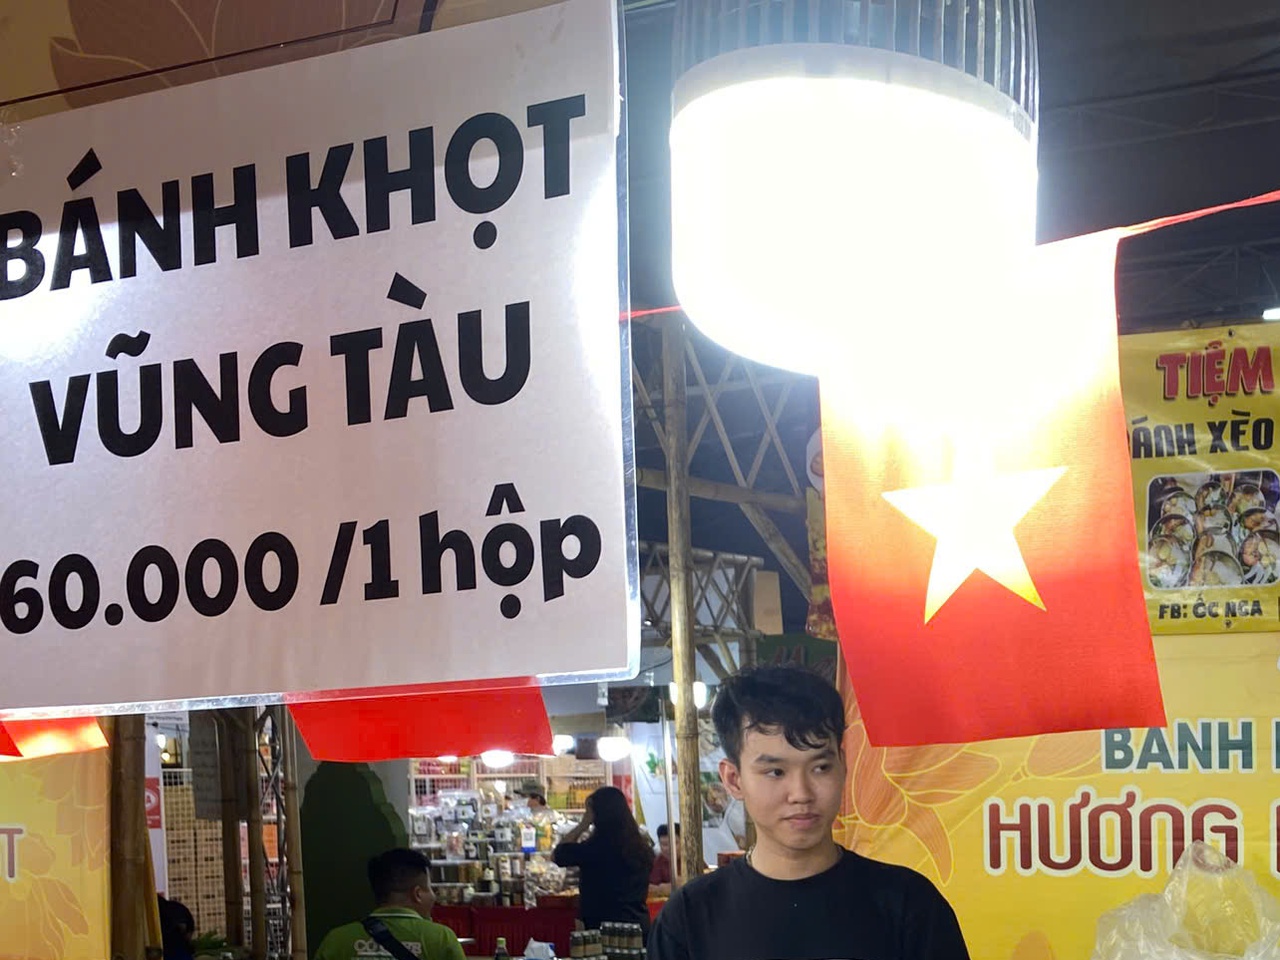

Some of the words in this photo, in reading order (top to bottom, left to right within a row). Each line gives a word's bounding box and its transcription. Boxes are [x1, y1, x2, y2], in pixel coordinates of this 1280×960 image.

[0, 148, 260, 300] BÁNH
[286, 94, 586, 250] KHỌT
[29, 330, 309, 466] VŨNG
[330, 272, 531, 426] TÀU
[1157, 340, 1276, 406] TIỆM
[1127, 415, 1197, 459] ÁNH
[1207, 409, 1275, 454] XÈO
[0, 531, 299, 635] 60.000
[419, 482, 601, 619] hộp
[1158, 603, 1188, 620] FB:
[1224, 600, 1264, 618] NGA
[989, 791, 1238, 873] HƯƠNG
